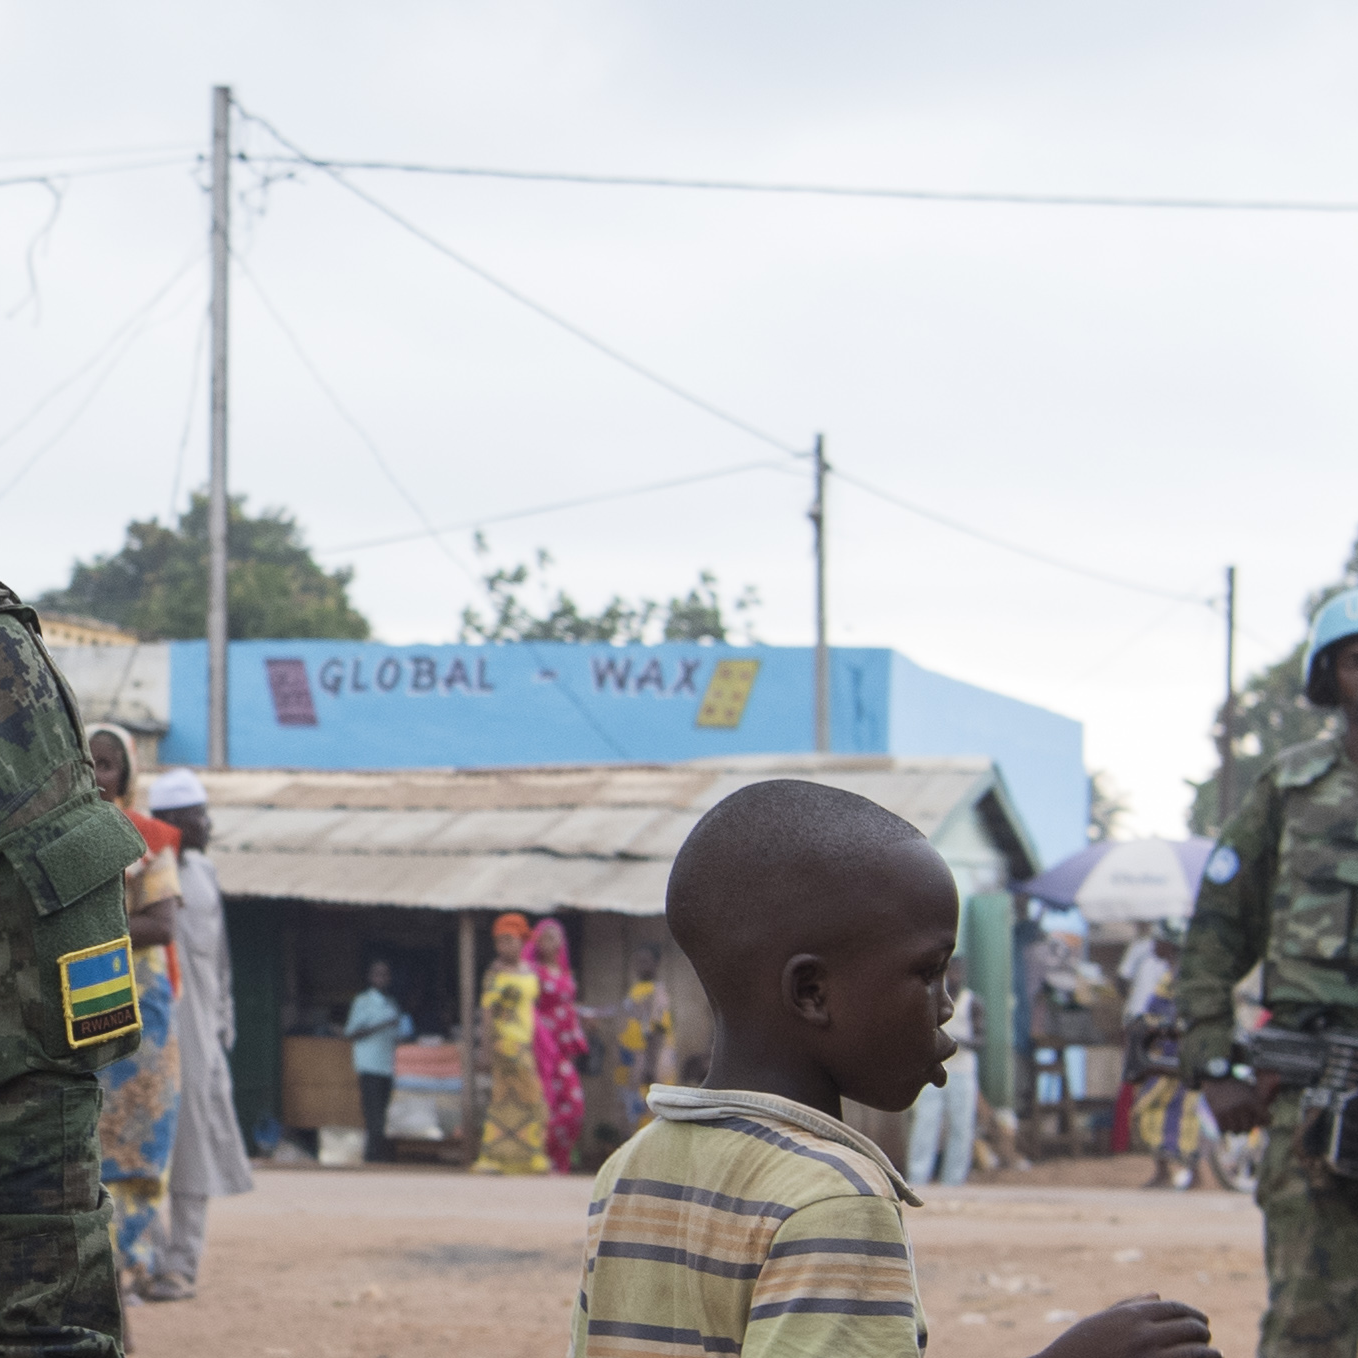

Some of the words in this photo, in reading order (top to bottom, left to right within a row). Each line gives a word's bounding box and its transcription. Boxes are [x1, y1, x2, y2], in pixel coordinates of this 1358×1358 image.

[318, 657, 496, 696] GLOBAL
[590, 656, 702, 696] WAX
[81, 1009, 133, 1034] RWANDA
